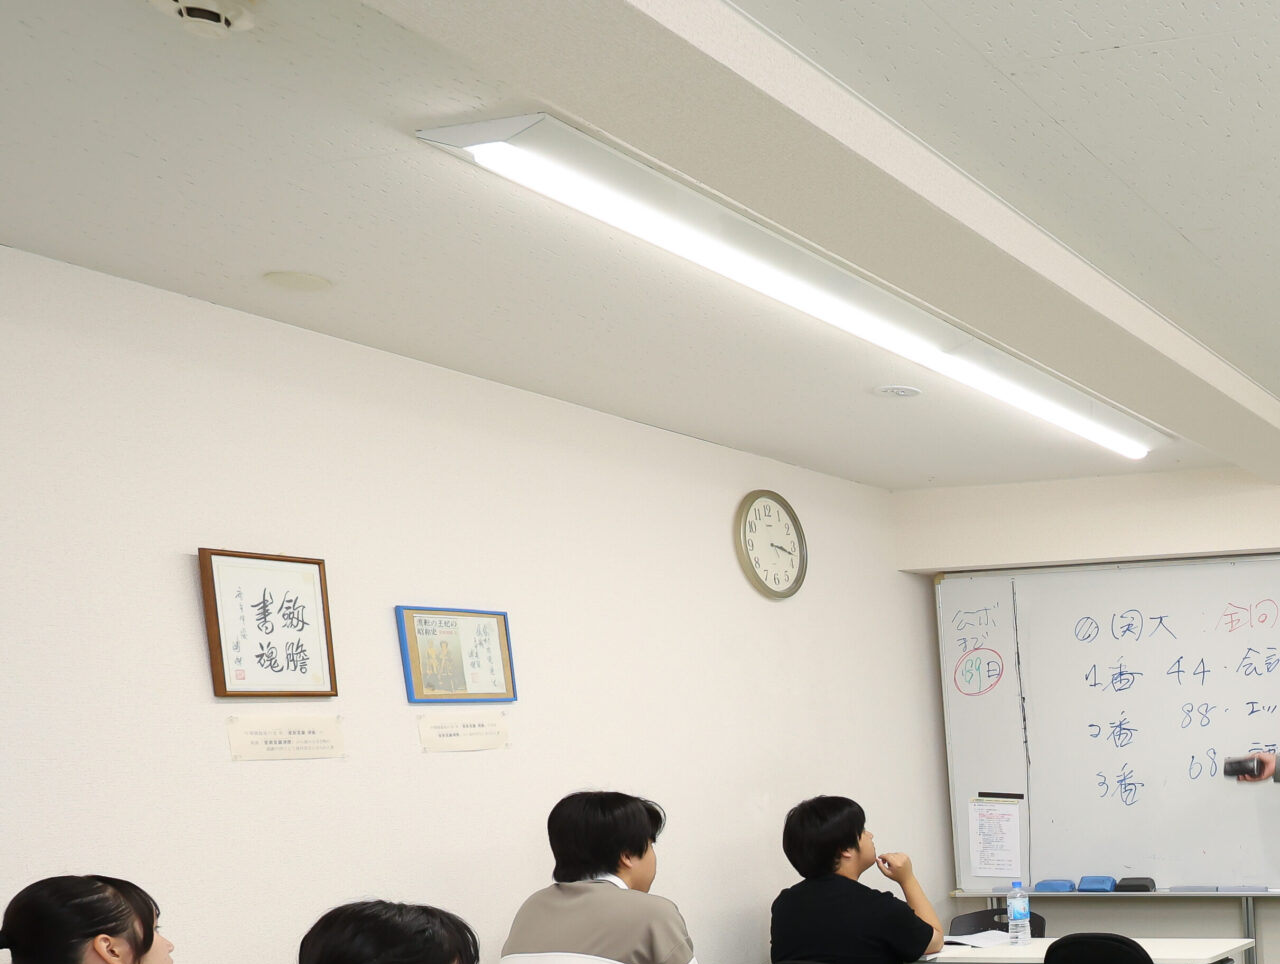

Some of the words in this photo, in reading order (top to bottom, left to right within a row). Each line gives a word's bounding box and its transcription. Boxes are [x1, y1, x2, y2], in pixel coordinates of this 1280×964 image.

[754, 507, 761, 521] 11
[763, 504, 772, 518] 12
[776, 509, 781, 522] 1
[748, 520, 757, 534] 10
[784, 522, 790, 536] 2
[747, 539, 754, 552] 9
[790, 541, 796, 553] 3
[754, 556, 760, 569] 8
[763, 569, 769, 582] 7
[773, 573, 780, 586] 6
[784, 570, 790, 582] 5
[1085, 656, 1144, 692] 1番
[1166, 656, 1211, 686] 44
[1088, 711, 1139, 748] 2番
[1181, 703, 1217, 728] 88
[1096, 762, 1145, 806] 3番
[1189, 748, 1218, 779] 68
